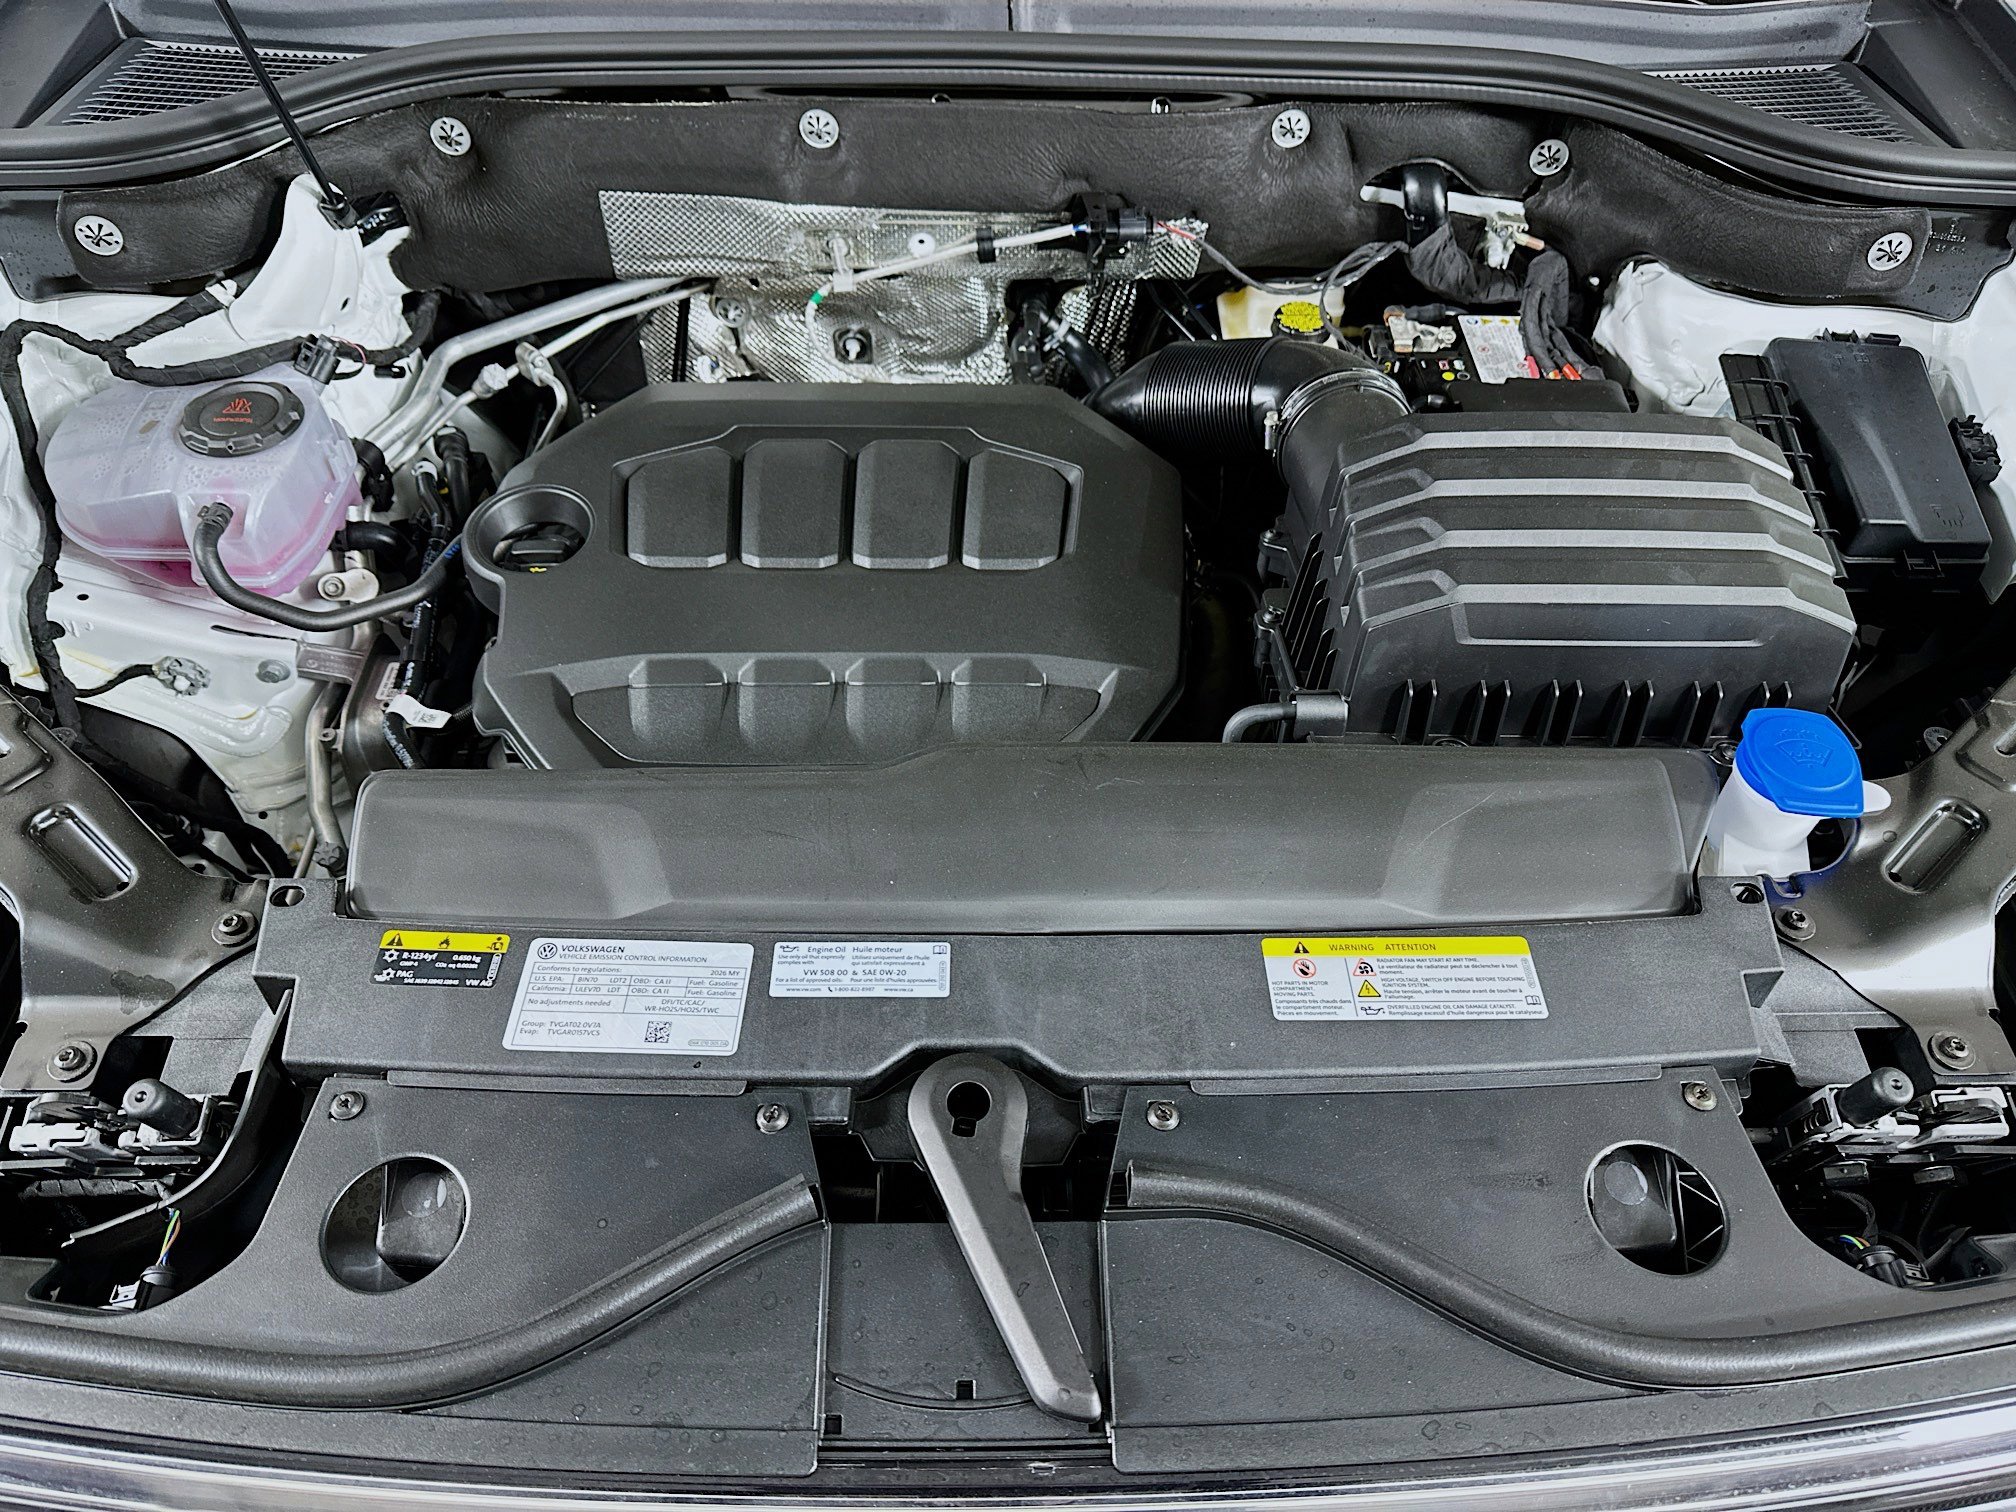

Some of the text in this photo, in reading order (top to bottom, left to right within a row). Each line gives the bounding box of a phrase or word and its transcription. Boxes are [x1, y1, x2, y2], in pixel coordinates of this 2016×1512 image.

[561, 944, 625, 953] VOLKSWAGEN
[807, 946, 833, 954] Engine
[402, 952, 438, 961] R-1234yf
[472, 955, 481, 963] kg
[539, 999, 584, 1007] adjustments
[522, 1020, 546, 1028] Group:
